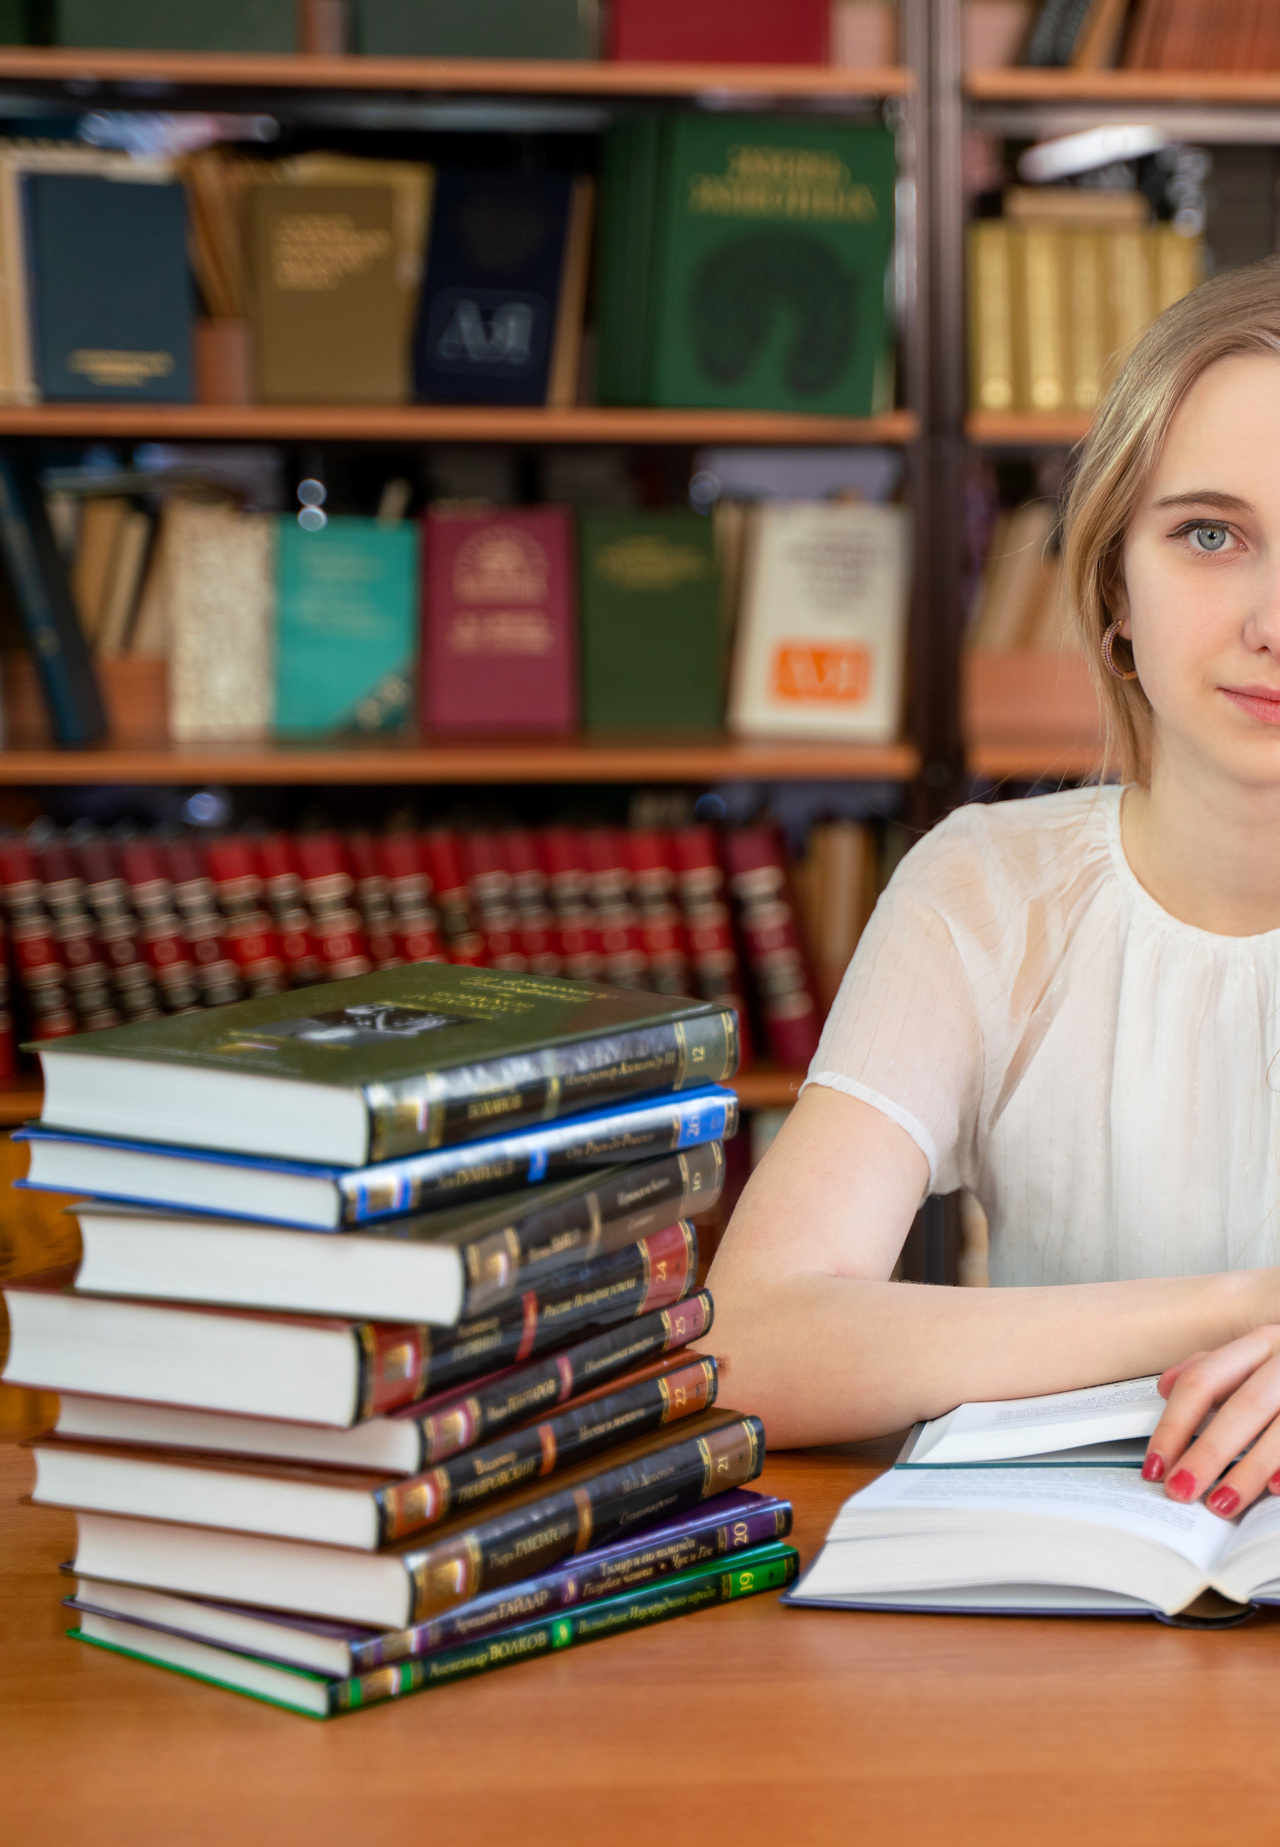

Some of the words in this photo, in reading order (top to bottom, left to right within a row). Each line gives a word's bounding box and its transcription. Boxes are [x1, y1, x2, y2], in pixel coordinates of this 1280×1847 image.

[692, 1045, 705, 1063] 12
[687, 1115, 700, 1137] 26
[692, 1171, 701, 1191] 16
[655, 1260, 667, 1283] 24
[675, 1316, 687, 1337] 23
[675, 1385, 687, 1408] 22
[717, 1455, 729, 1473] 21
[514, 1521, 571, 1556] ГАМЗАТОВ
[733, 1522, 748, 1546] 20
[600, 1557, 634, 1577] Тимур
[655, 1538, 696, 1560] команда
[740, 1571, 755, 1592] 19
[498, 1590, 549, 1619] ГАЙДАР
[489, 1631, 548, 1662] ВОЛКОВ
